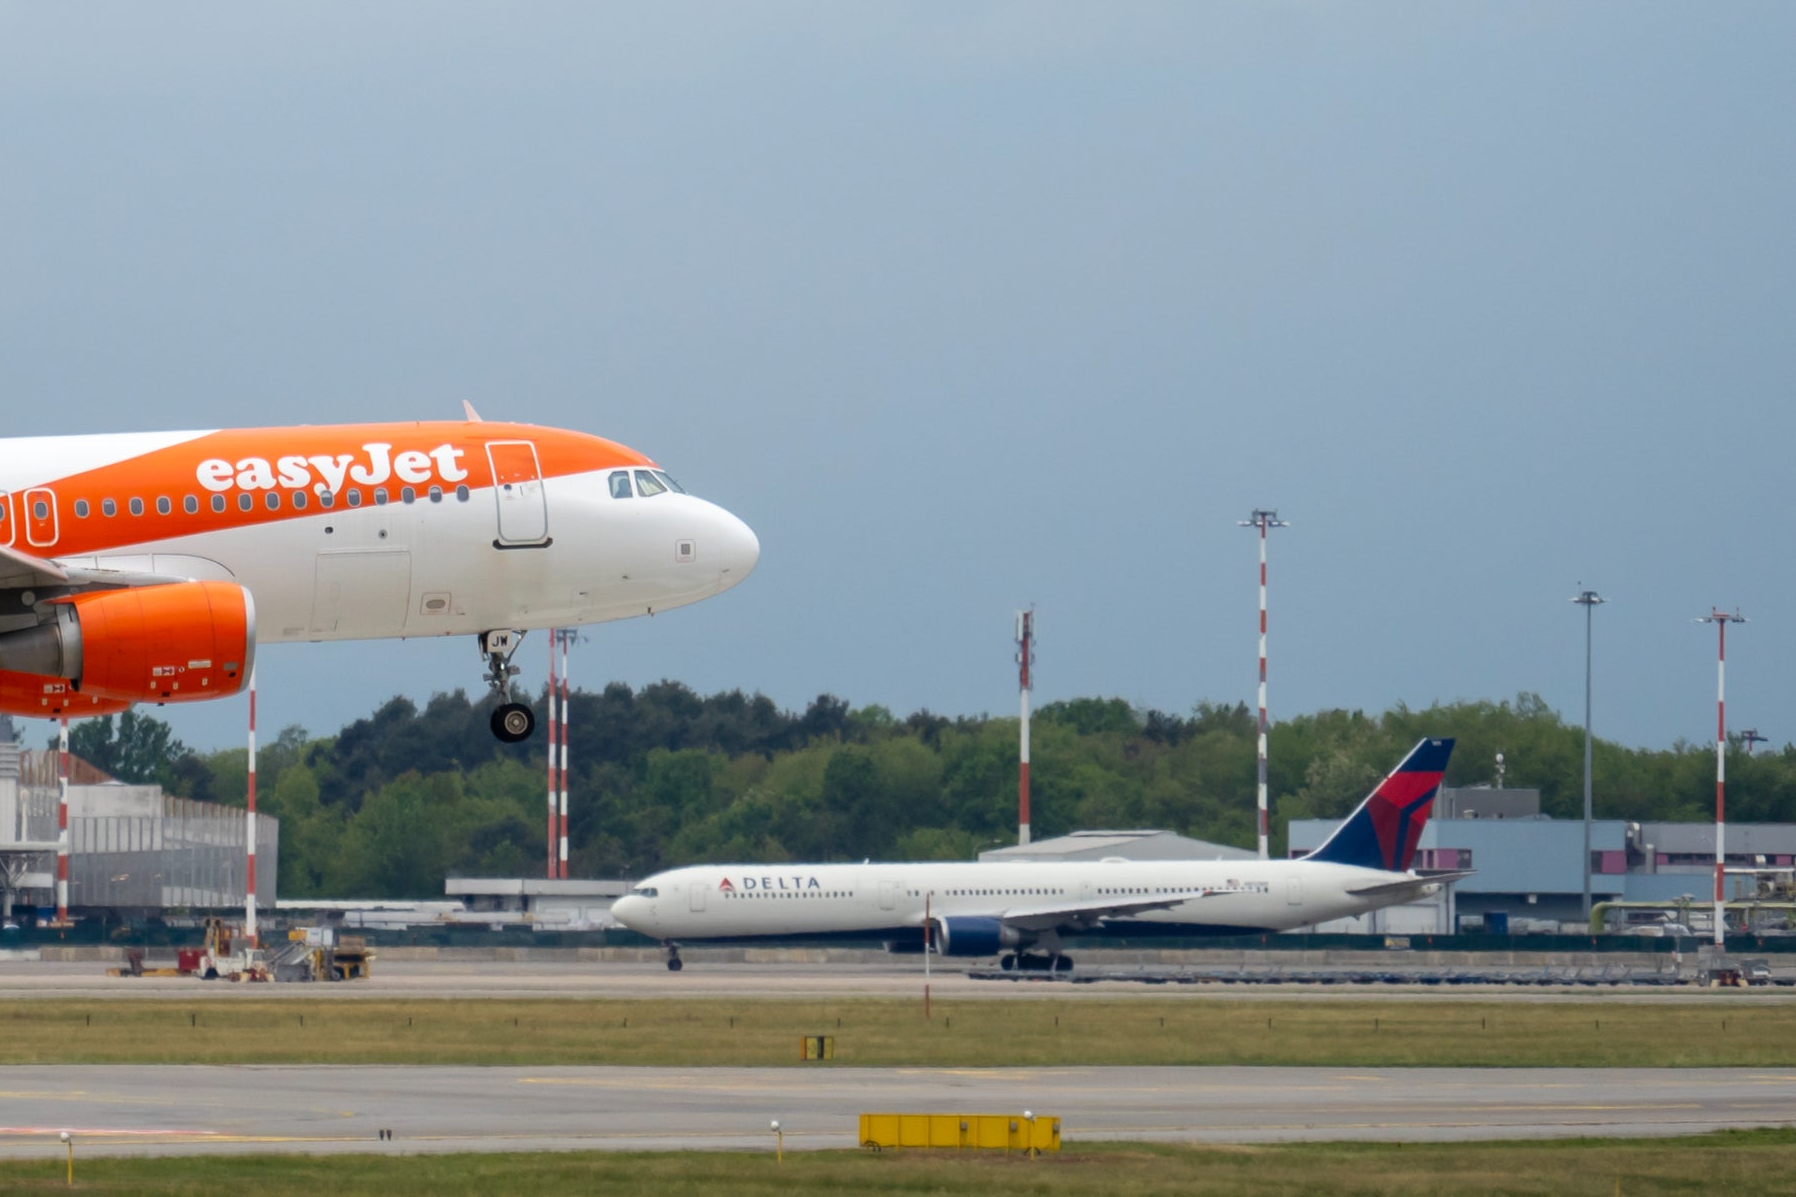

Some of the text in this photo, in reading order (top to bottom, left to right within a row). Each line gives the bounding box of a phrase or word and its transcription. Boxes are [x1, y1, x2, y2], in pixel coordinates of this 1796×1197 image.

[195, 443, 469, 496] easyJet
[491, 635, 508, 647] JW
[742, 876, 821, 890] DELTA
